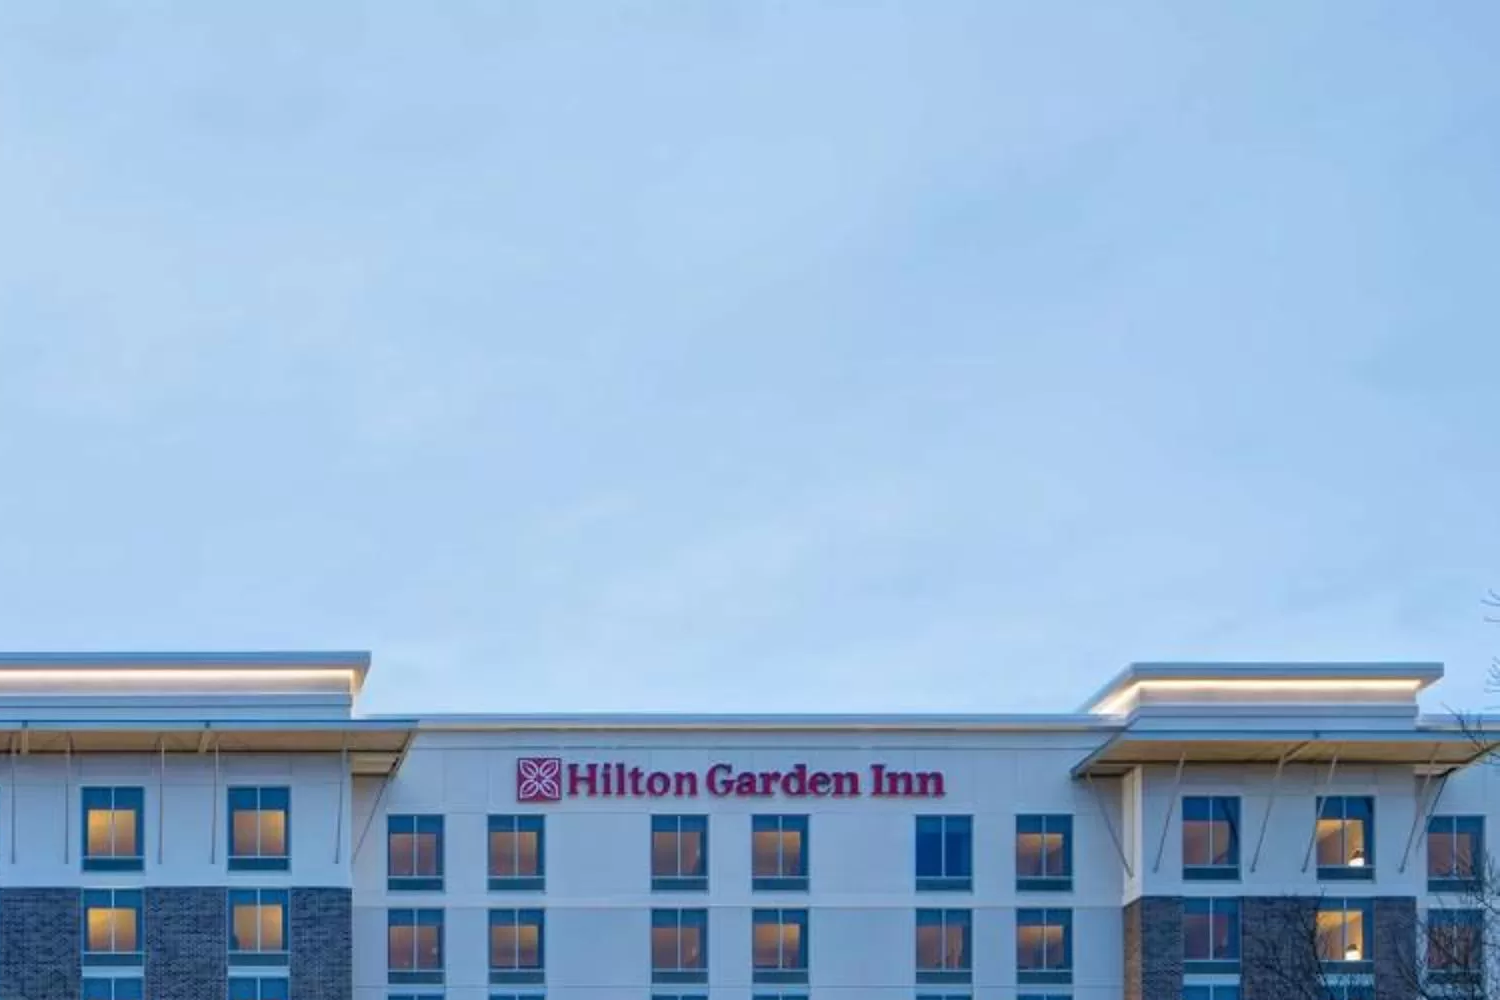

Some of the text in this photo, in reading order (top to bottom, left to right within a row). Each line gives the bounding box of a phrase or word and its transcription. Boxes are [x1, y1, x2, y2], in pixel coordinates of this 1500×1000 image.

[567, 762, 946, 798] Hilton Garden Inn
